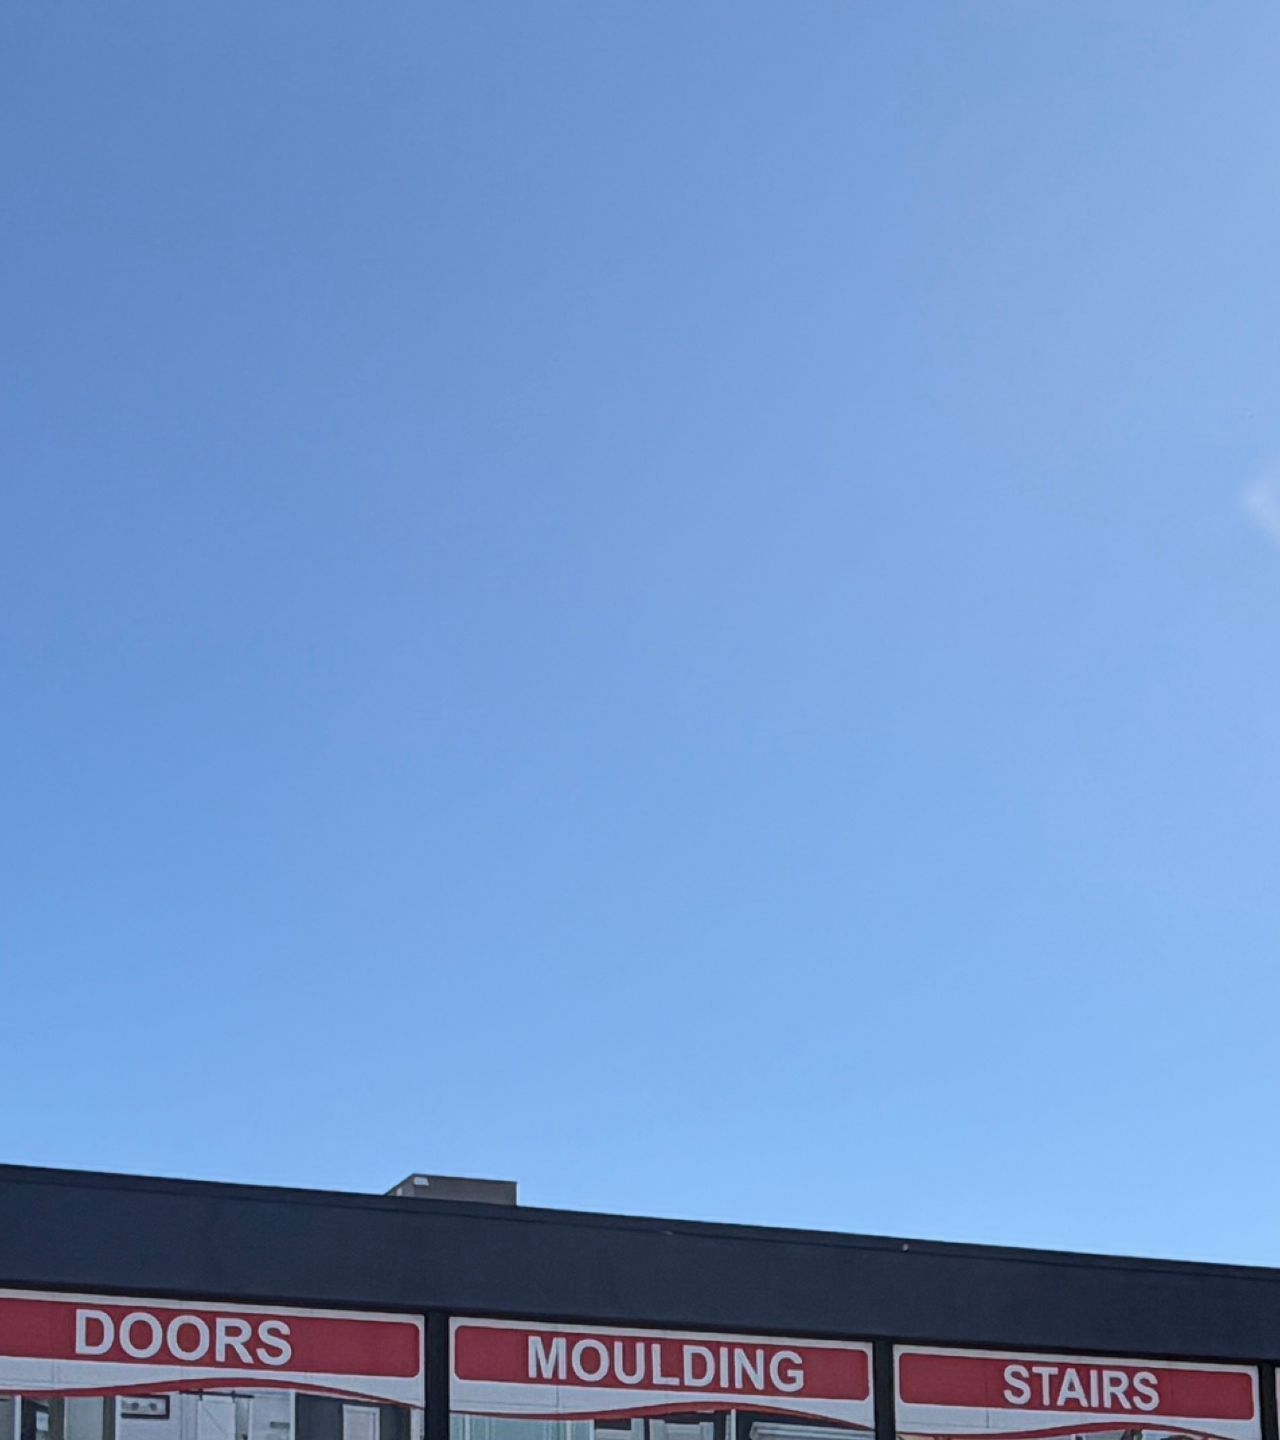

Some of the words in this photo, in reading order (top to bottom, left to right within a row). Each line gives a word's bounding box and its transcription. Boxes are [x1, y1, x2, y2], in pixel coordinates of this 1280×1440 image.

[75, 1308, 293, 1366] DOORS
[526, 1336, 805, 1393] MOULDING
[1003, 1363, 1160, 1411] STAIRS
